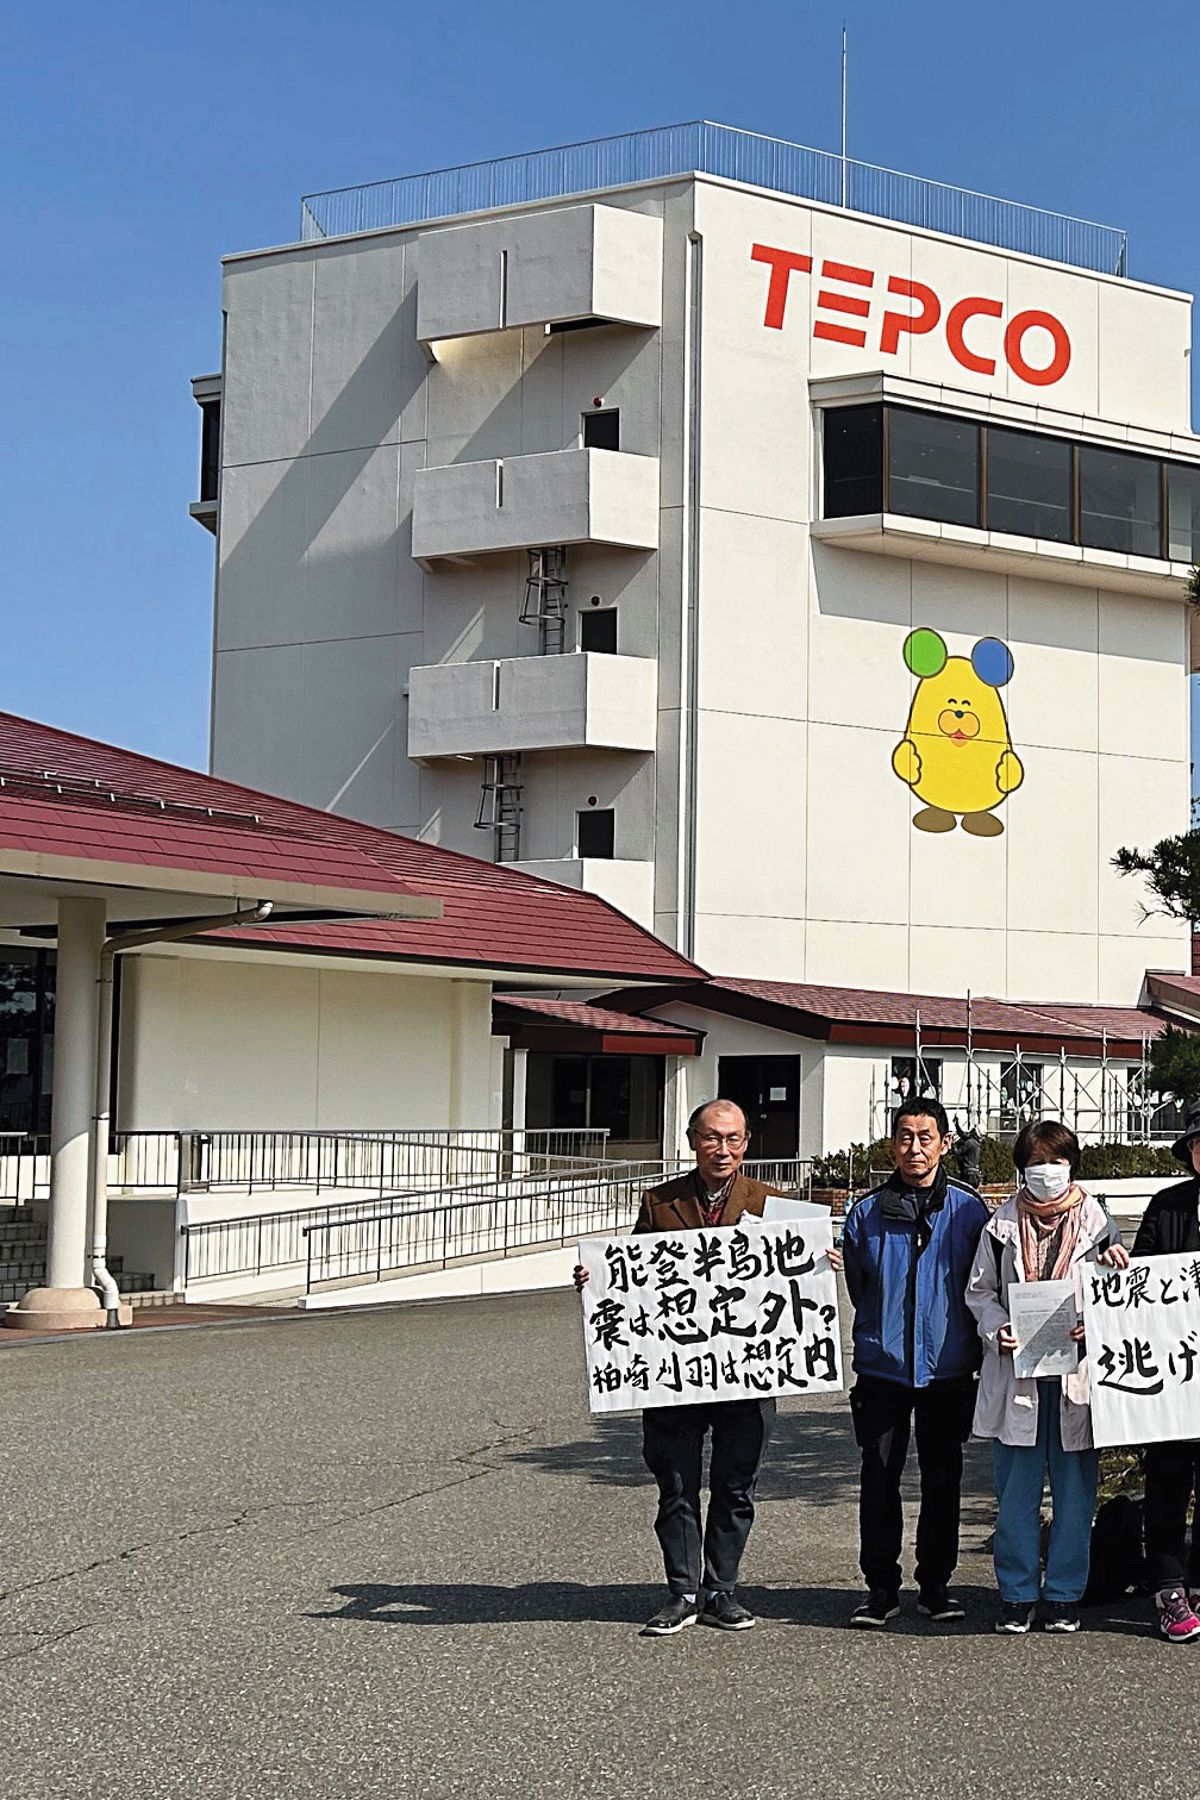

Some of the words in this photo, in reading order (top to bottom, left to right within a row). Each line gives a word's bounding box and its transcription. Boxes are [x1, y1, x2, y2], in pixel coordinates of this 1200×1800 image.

[751, 243, 1071, 386] TEPCO
[605, 1229, 814, 1293] 能登半島地
[589, 1279, 836, 1350] 震は想定外?
[592, 1333, 838, 1393] 柏崎刈羽は想定内
